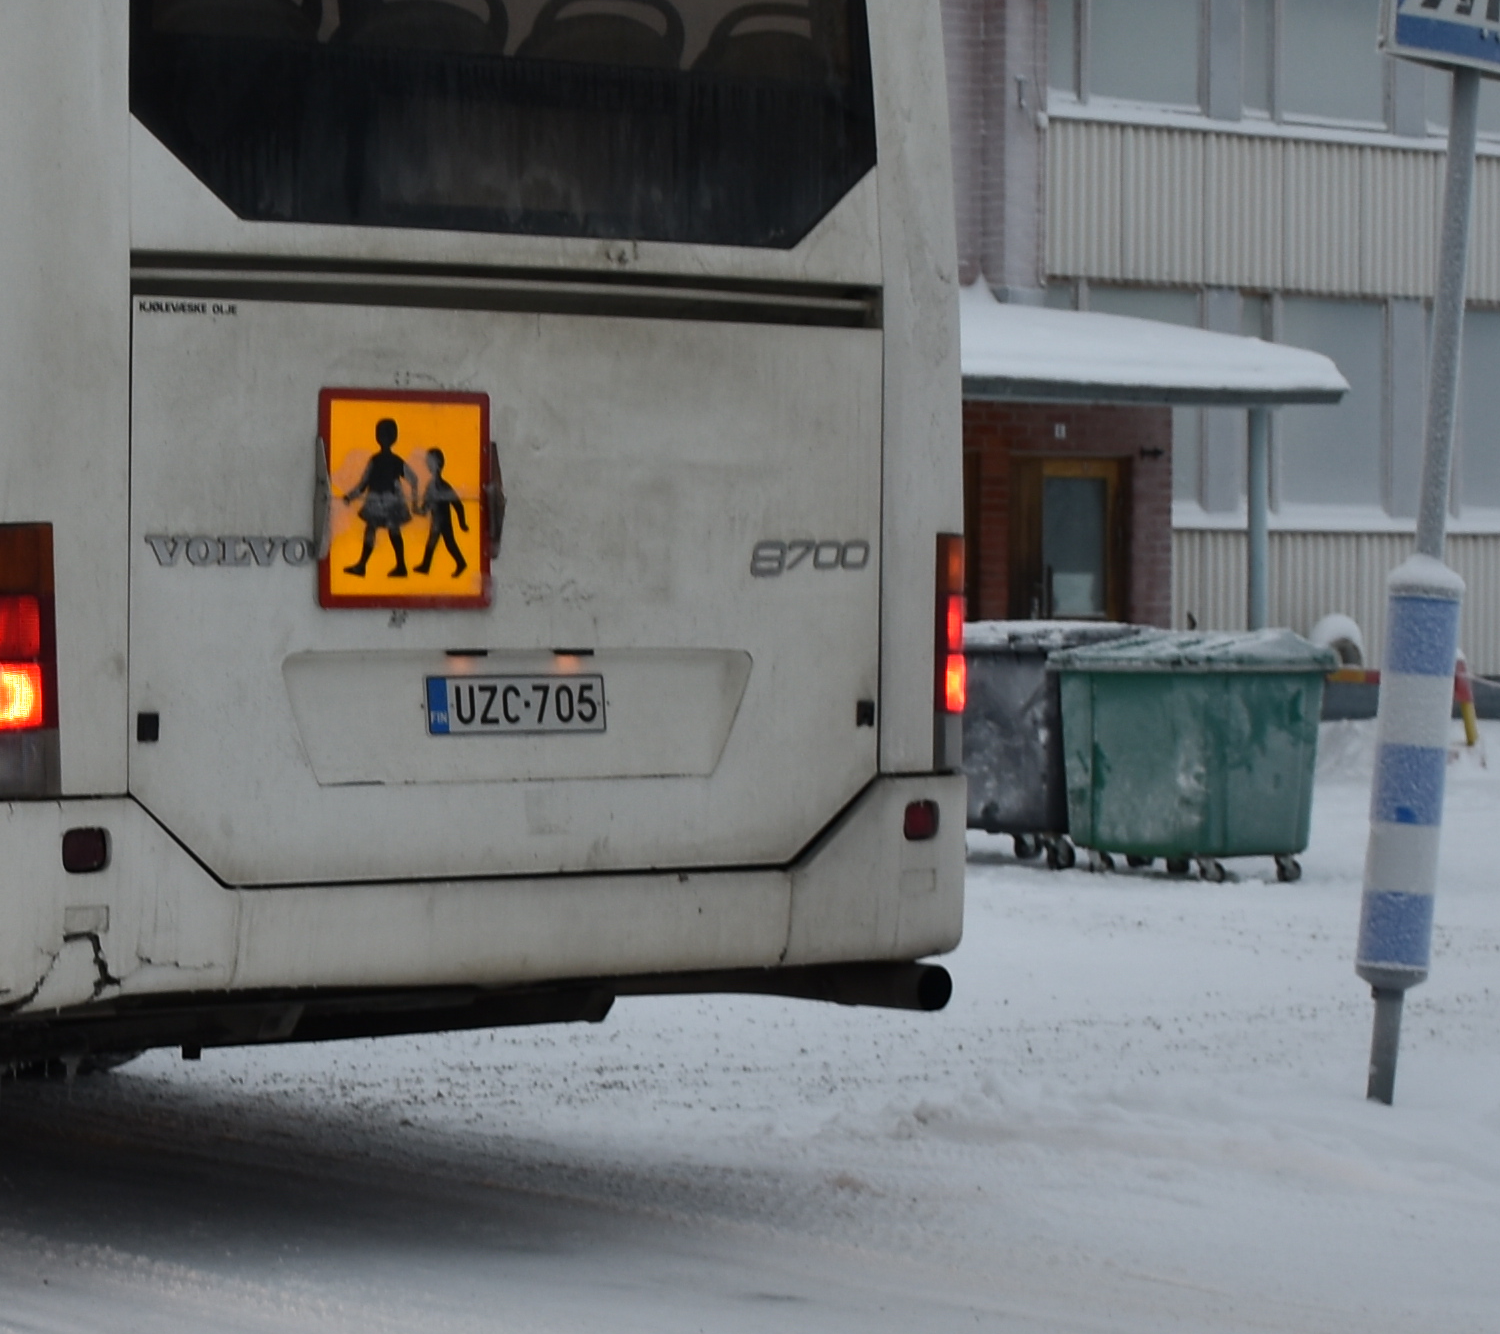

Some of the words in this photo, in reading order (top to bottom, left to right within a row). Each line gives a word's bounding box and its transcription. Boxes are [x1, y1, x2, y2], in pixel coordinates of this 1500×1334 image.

[212, 303, 238, 315] OLJE
[144, 534, 318, 567] VOLVO
[750, 539, 870, 577] 8700
